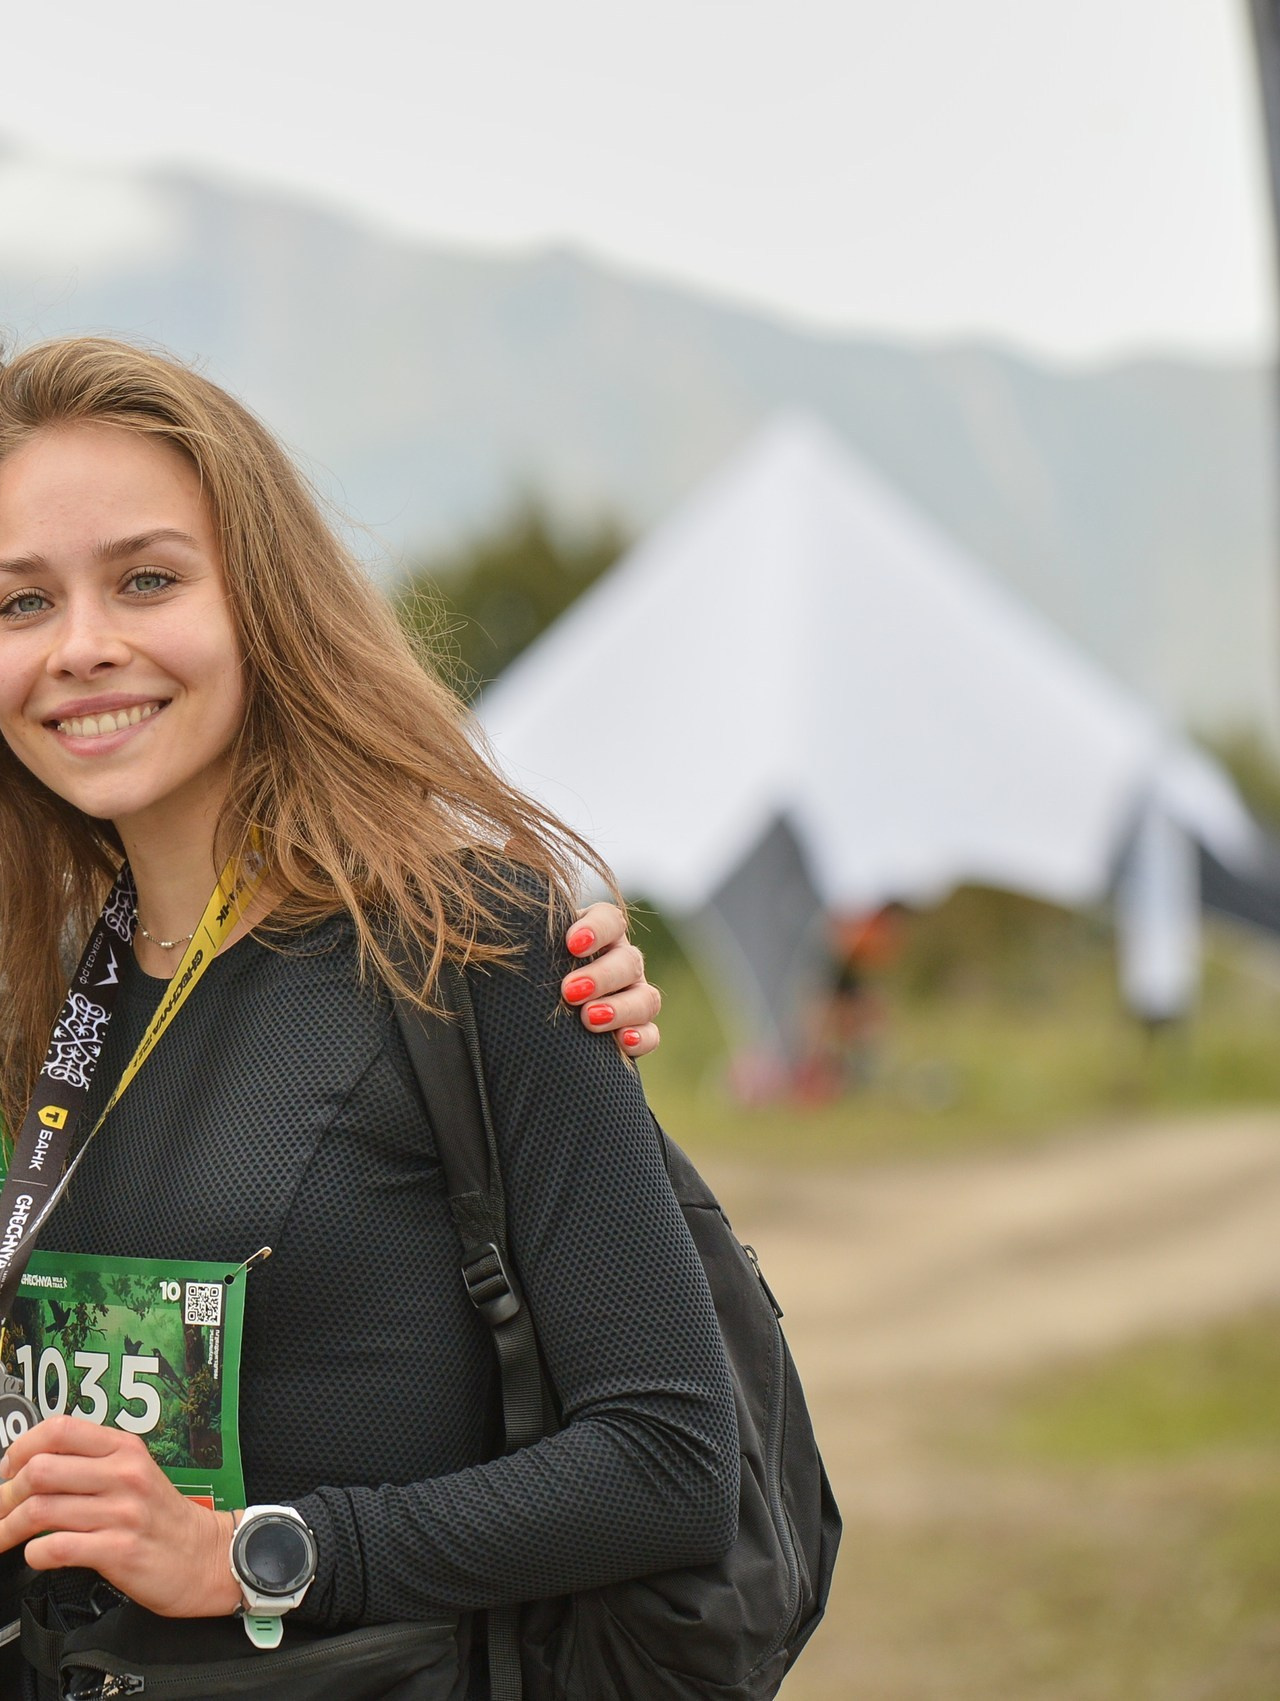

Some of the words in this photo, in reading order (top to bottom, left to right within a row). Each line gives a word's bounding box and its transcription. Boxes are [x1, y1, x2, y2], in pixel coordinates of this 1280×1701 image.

[29, 1129, 54, 1171] БАНК
[159, 1281, 181, 1300] 10
[16, 1344, 163, 1434] 1035
